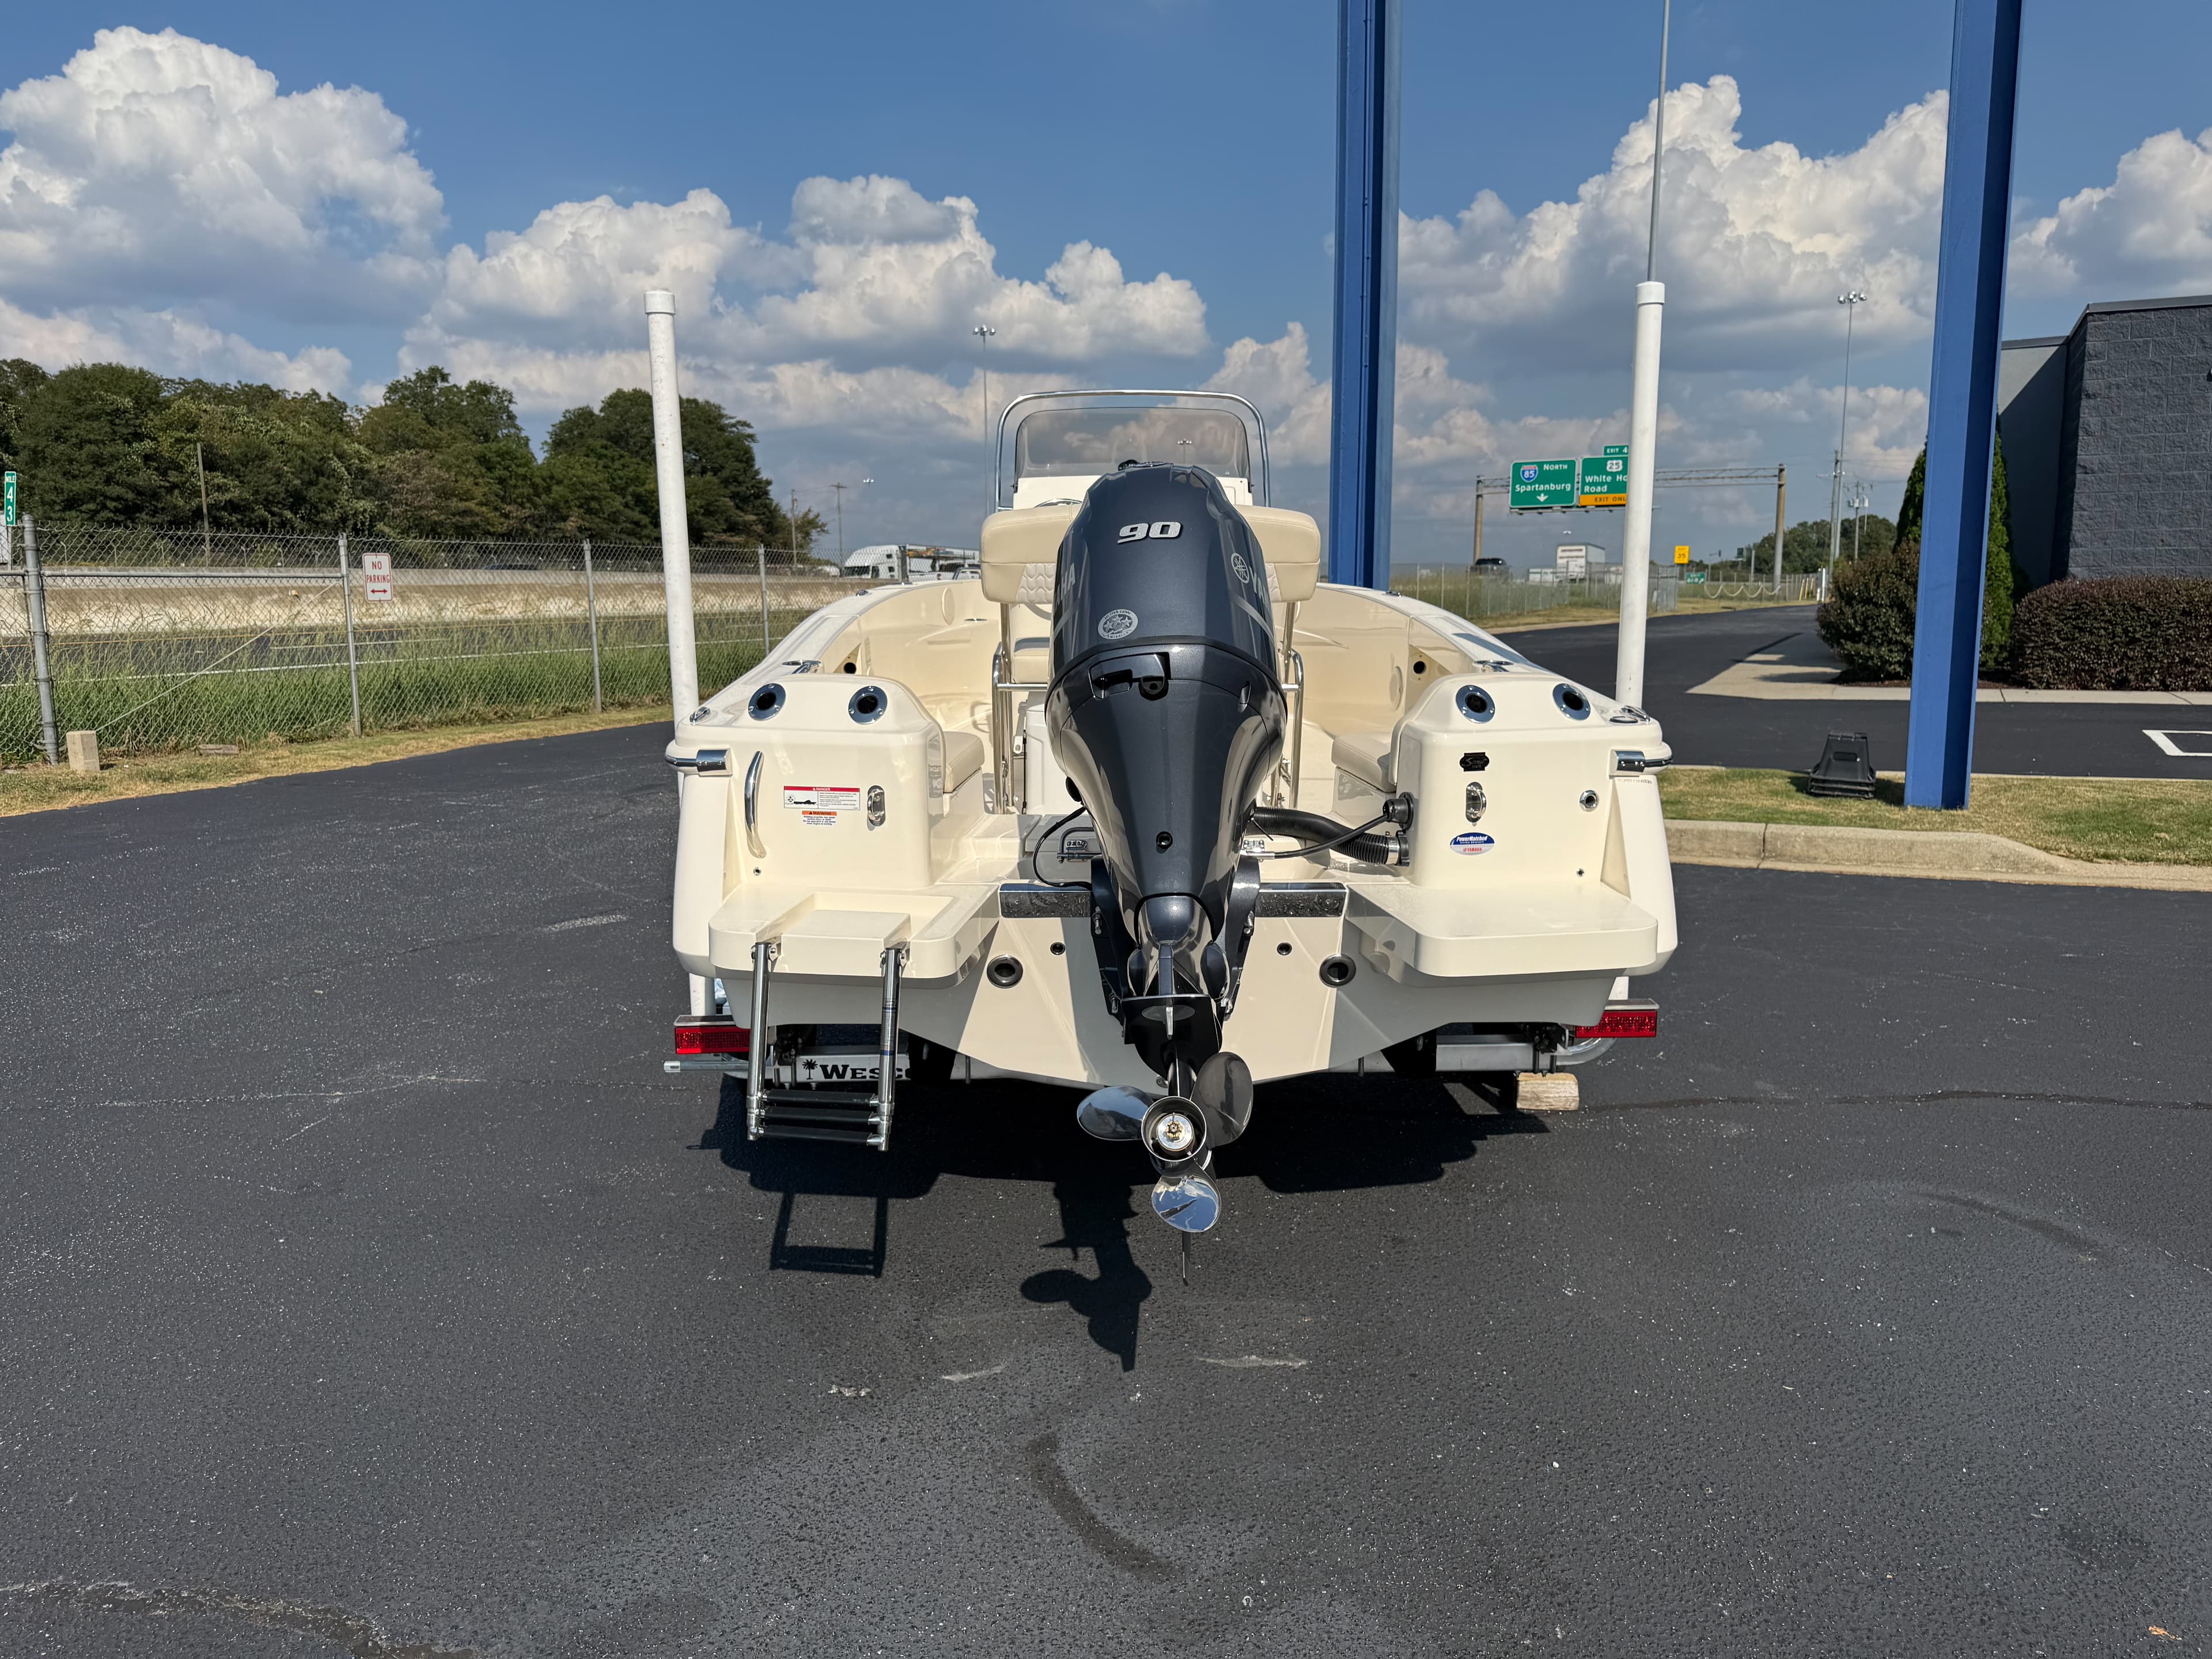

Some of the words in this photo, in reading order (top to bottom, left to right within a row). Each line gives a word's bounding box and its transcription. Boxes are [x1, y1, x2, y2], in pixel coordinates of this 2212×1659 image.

[1524, 470, 1535, 478] 85
[1515, 483, 1571, 493] Spartanburg
[1584, 485, 1608, 493] Road
[1117, 521, 1181, 544] 90
[372, 561, 382, 570] NO
[366, 574, 390, 583] PARKING
